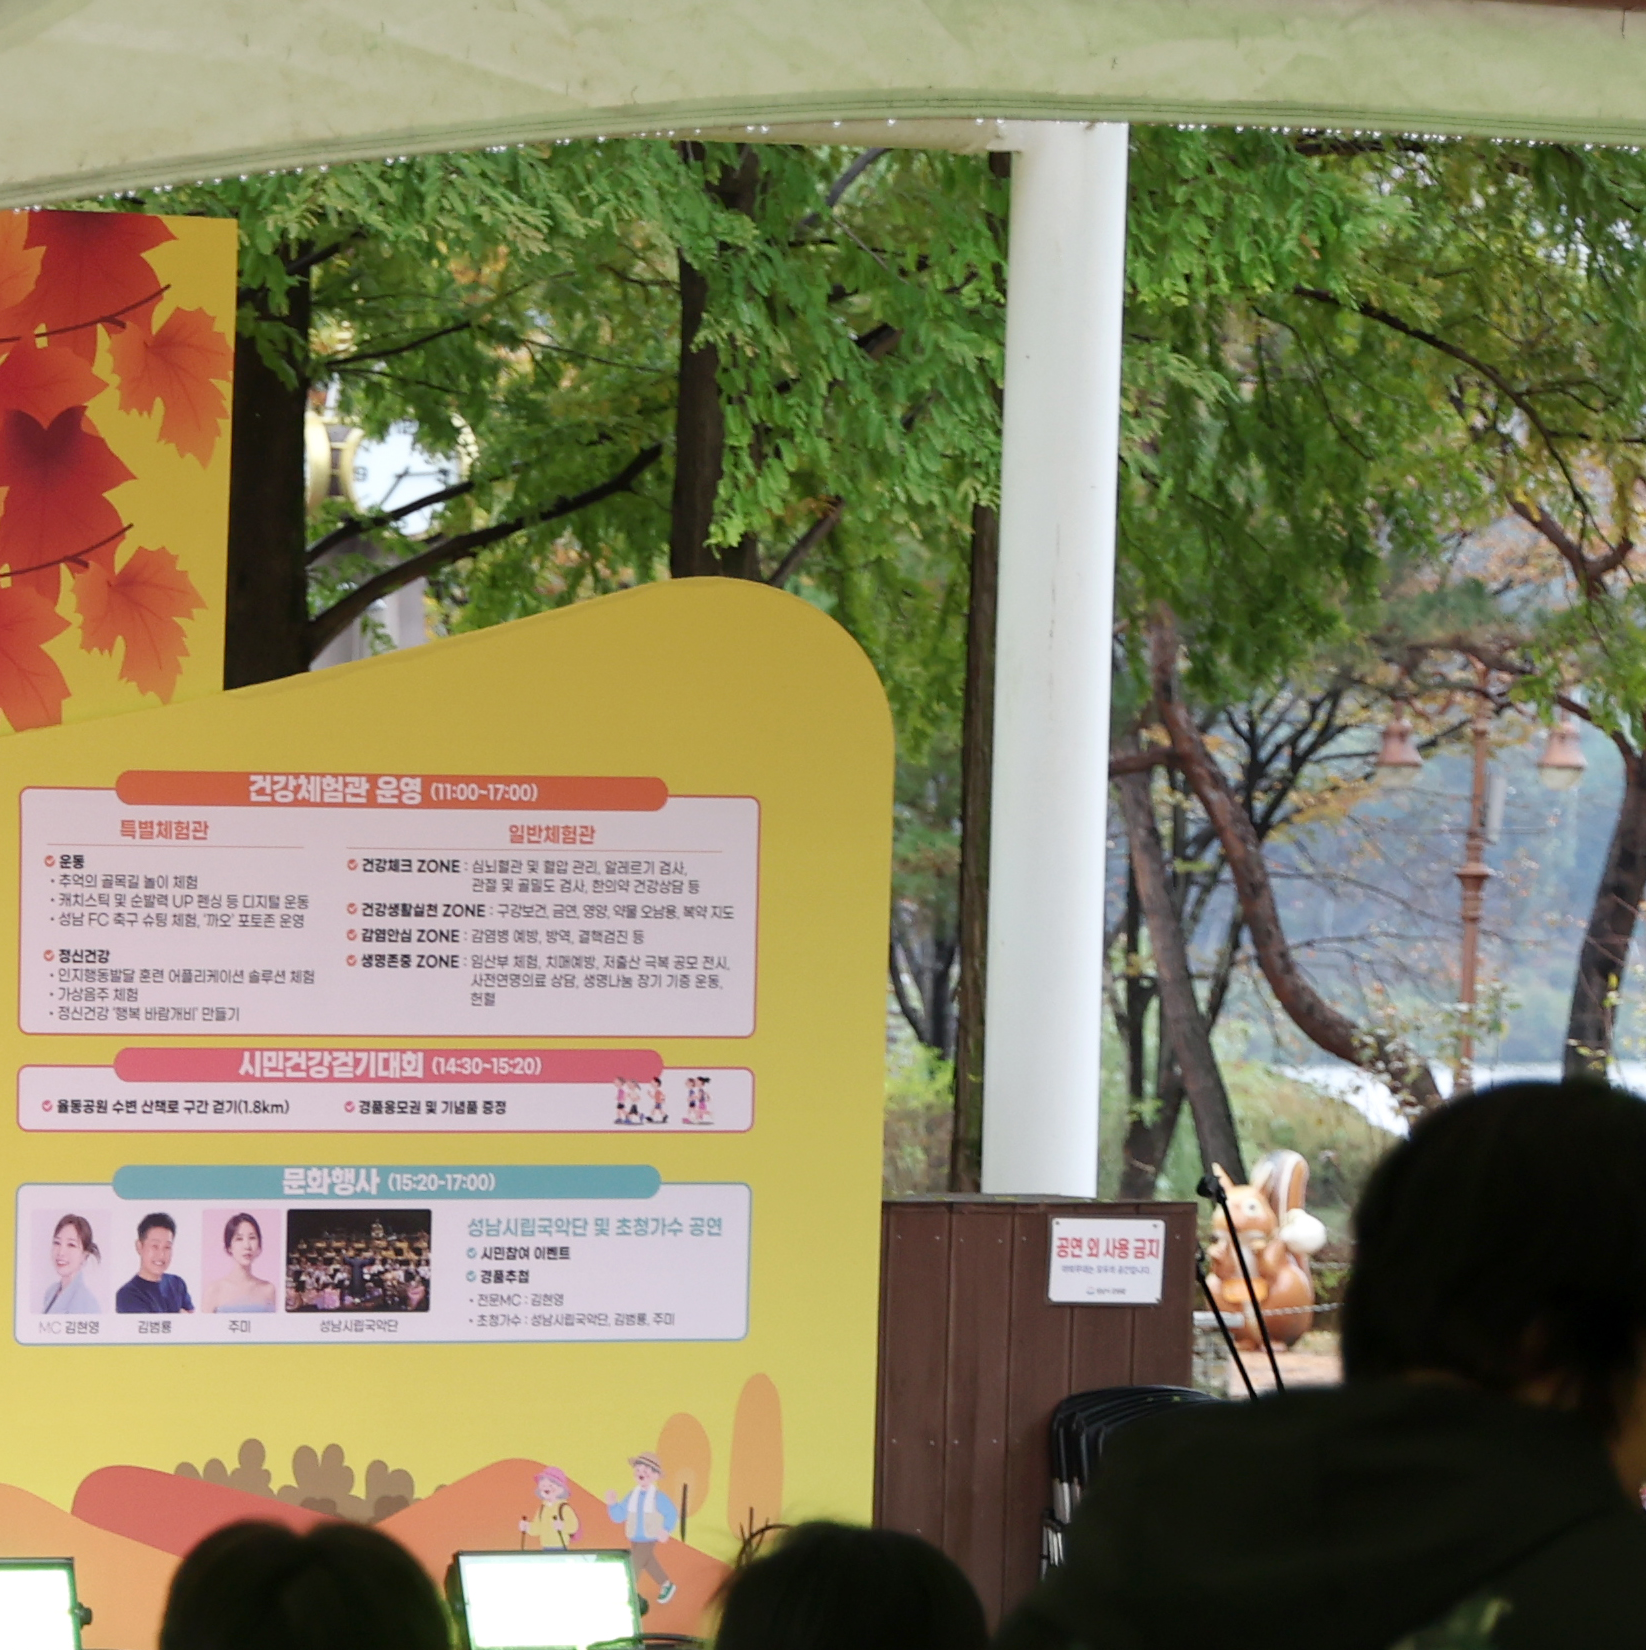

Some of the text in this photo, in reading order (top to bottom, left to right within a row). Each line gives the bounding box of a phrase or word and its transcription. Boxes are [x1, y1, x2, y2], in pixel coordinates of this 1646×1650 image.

[249, 774, 370, 803] 건강체험관
[376, 776, 422, 805] 운영
[120, 819, 209, 841] 특별체험관
[509, 824, 596, 845] 일반체험관
[59, 854, 85, 869] 운동
[362, 858, 413, 874] 건강체크
[416, 858, 461, 873] ZONE
[527, 860, 539, 874] 및
[543, 860, 568, 875] 혈압
[572, 860, 601, 875] 관리,
[605, 860, 655, 876] 알레르기
[659, 861, 687, 876] 검사,
[59, 873, 198, 890] 추억의 골목길 놀이 체험
[472, 878, 497, 893] 관절
[501, 878, 513, 893] 및
[560, 879, 588, 894] 검사,
[592, 878, 630, 894] 한의약
[634, 879, 684, 894] 건강상담
[688, 880, 700, 894] 등
[114, 893, 126, 908] 및
[131, 893, 168, 908] 순발력
[172, 894, 194, 908] UP
[227, 894, 238, 909] 등
[242, 894, 280, 909] 디지털
[284, 895, 309, 910] 운동
[361, 902, 438, 919] 건강생활실천
[442, 903, 486, 918] ZONE
[497, 903, 549, 920] 구강보건,
[641, 904, 680, 921] 오남용,
[711, 905, 734, 919] 지도
[59, 912, 85, 927] 성남
[88, 912, 109, 927] FC
[172, 913, 200, 929] 체험,
[238, 912, 275, 928] 포토존
[280, 913, 304, 929] 운영
[361, 928, 412, 943] 감염안심
[416, 928, 460, 944] ZONE
[472, 929, 509, 944] 감염병
[513, 929, 541, 945] 예방,
[633, 929, 644, 945] 등
[59, 949, 110, 964] 정신건강
[361, 953, 412, 969] 생명존중
[415, 953, 460, 970] ZONE
[471, 954, 509, 969] 임산부
[513, 954, 541, 970] 체험,
[645, 955, 669, 969] 극복
[674, 955, 698, 970] 공모
[58, 968, 135, 983] 인지행동발달
[139, 967, 164, 983] 훈련
[249, 969, 286, 984] 솔루션
[290, 969, 315, 985] 체험
[471, 973, 546, 988] 사전연명의료
[667, 974, 690, 989] 기증
[58, 987, 138, 1002] 가상음주 체험
[58, 1006, 109, 1021] 정신건강
[202, 1007, 239, 1022] 만들기
[238, 1051, 424, 1079] 시민건강걷기대회
[57, 1099, 108, 1114] 율동공원
[112, 1099, 137, 1114] 수변
[141, 1100, 179, 1114] 산책로
[183, 1099, 209, 1115] 구간
[359, 1100, 507, 1115] 경품응모권 및 기념품 증정
[283, 1168, 380, 1194] 문화행사
[468, 1217, 722, 1237] 성남시립국악단 및 초청가수 공연
[480, 1246, 571, 1261] 시민참여 이벤트
[1057, 1237, 1160, 1259] 공연 외 사용 금지
[480, 1269, 530, 1284] 경품추첨
[531, 1293, 564, 1307] 김현영
[39, 1320, 99, 1335] MC 김현영
[138, 1320, 172, 1334] 김범룡
[228, 1320, 251, 1333] 주미
[320, 1319, 399, 1333] 성남시립국악단
[477, 1314, 521, 1327] 초청가수
[531, 1313, 611, 1327] 성남시립국악단,
[615, 1313, 650, 1326] 김범룡,
[653, 1313, 675, 1325] 주미
